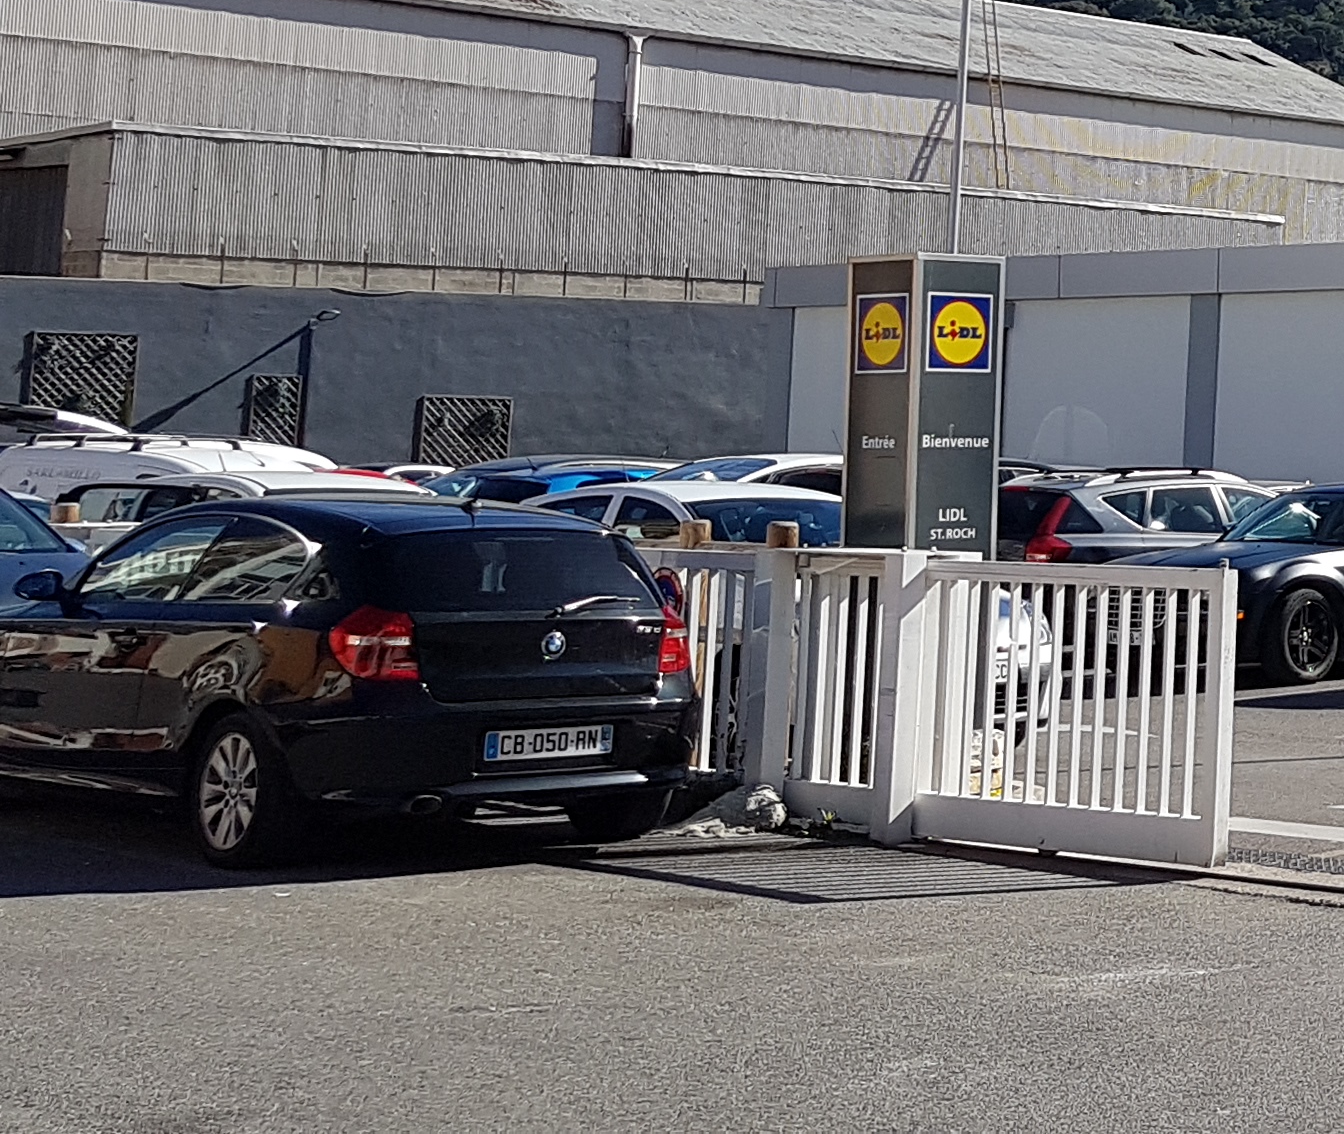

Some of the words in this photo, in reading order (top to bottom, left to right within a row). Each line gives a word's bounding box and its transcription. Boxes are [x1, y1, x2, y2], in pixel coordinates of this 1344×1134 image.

[861, 435, 896, 449] Entrée
[922, 434, 990, 448] Bienvenue
[938, 508, 968, 522] LIDL
